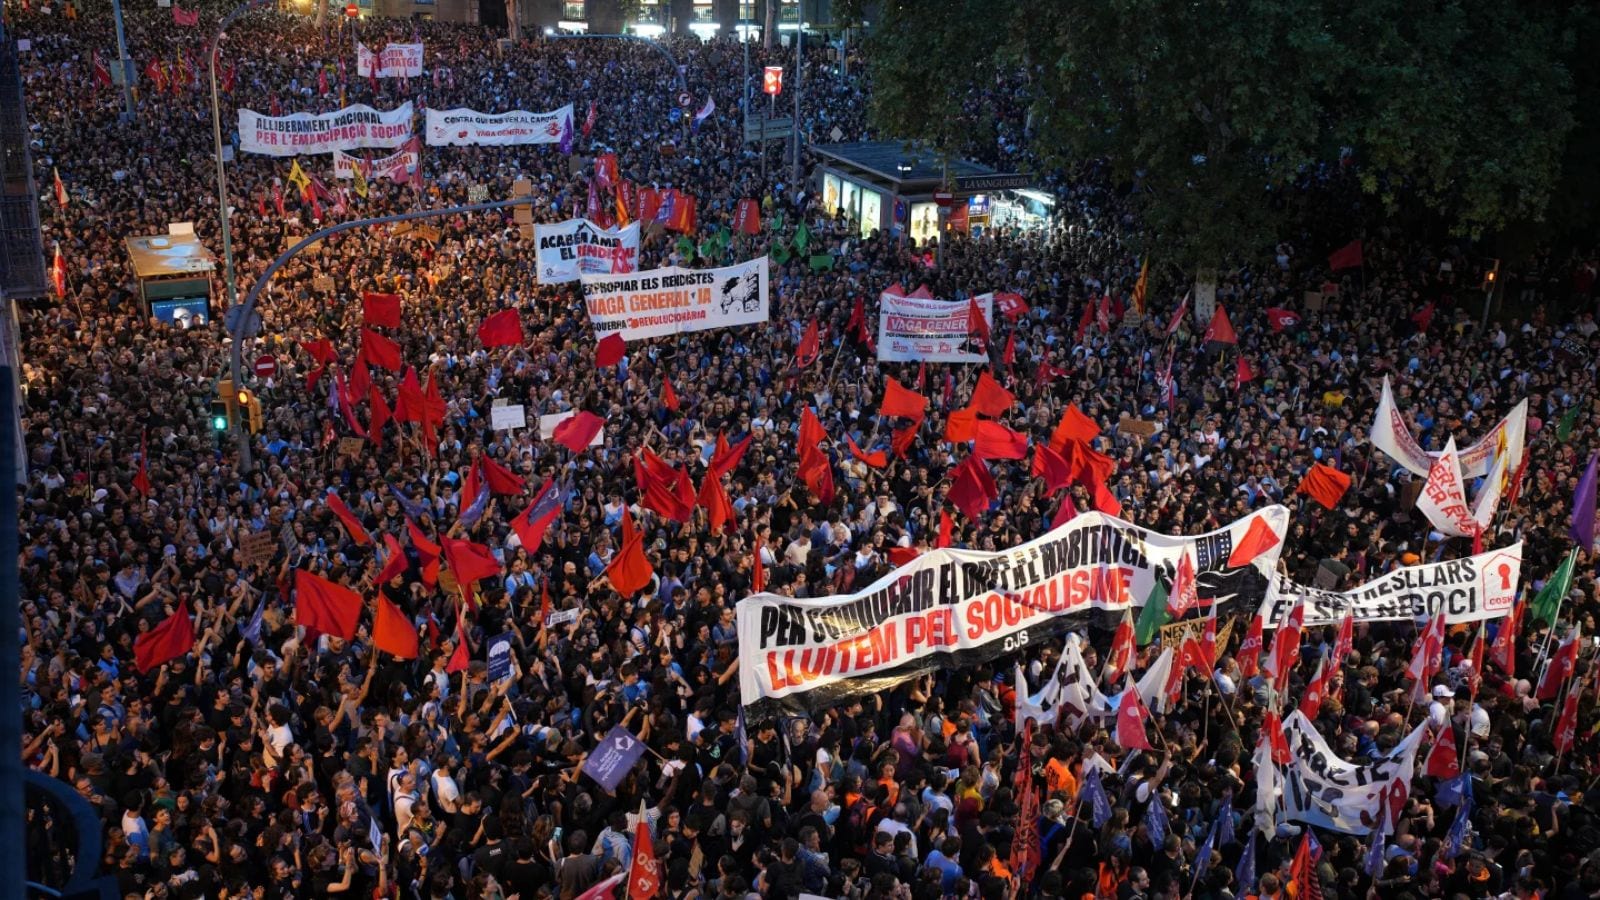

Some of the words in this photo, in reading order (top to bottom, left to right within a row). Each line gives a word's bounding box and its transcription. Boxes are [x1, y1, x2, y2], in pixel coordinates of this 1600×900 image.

[256, 117, 330, 133] ALLIBERAMENT
[333, 111, 382, 126] NACIONAL
[256, 131, 277, 145] PER
[282, 121, 367, 145] L'EMANCIPACIÓ
[976, 177, 1029, 189] VANGUARDIA
[560, 248, 576, 261] EL
[582, 279, 638, 297] EXPROPIAR
[641, 277, 659, 290] ELS
[662, 272, 714, 288] RENDISTES
[588, 295, 627, 316] VAGA
[630, 290, 692, 313] GENERAL
[891, 318, 922, 331] VAGA
[926, 318, 968, 331] GENER
[760, 603, 806, 650] PER
[938, 558, 960, 606] EL
[1376, 587, 1477, 619] NEGOCI
[766, 621, 899, 691] LLUITEM
[905, 608, 959, 655] PEL
[966, 566, 1134, 641] SOCIALISME
